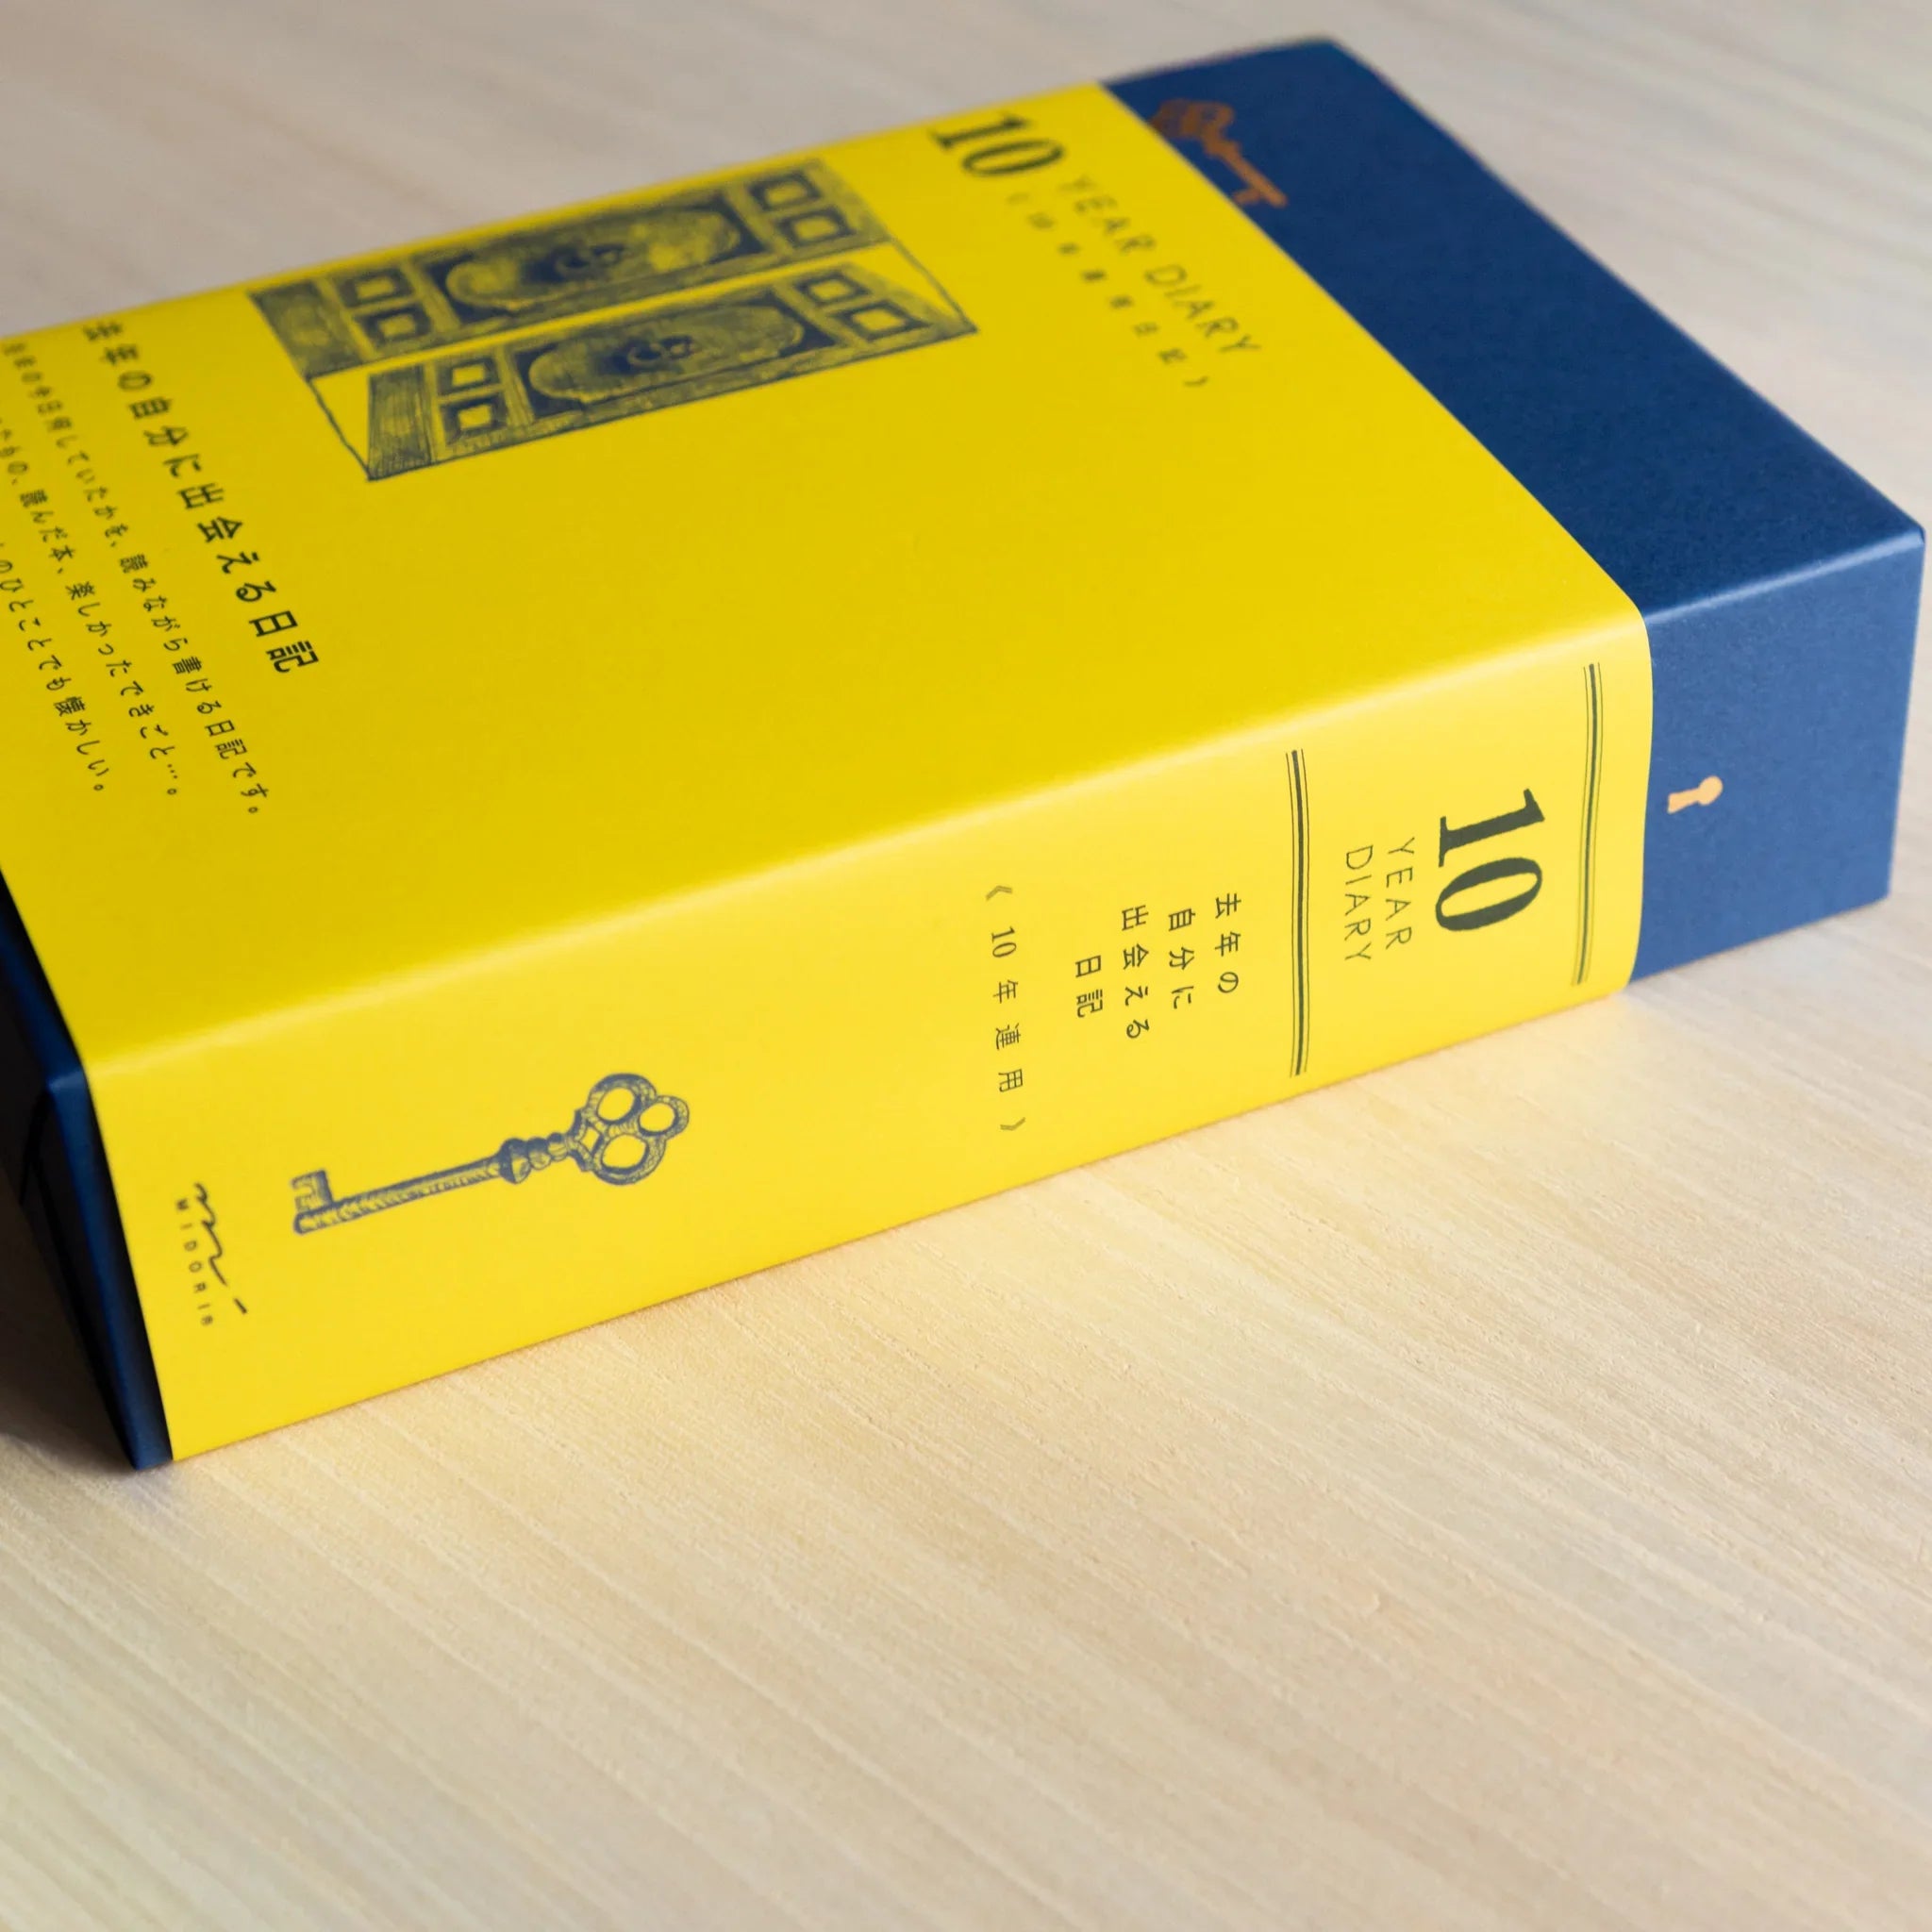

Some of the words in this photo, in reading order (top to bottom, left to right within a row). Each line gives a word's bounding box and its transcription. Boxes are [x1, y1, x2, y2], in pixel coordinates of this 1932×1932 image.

[930, 113, 1066, 177] 10
[1143, 265, 1260, 353] DIARY
[1344, 845, 1374, 960] DIARY
[1386, 837, 1415, 950] YEAR
[1435, 789, 1545, 932] 10
[1075, 955, 1103, 1018] 日記
[1122, 905, 1150, 1039] 出会える
[1168, 908, 1196, 1009] 自分に
[1214, 892, 1241, 993] 去年の
